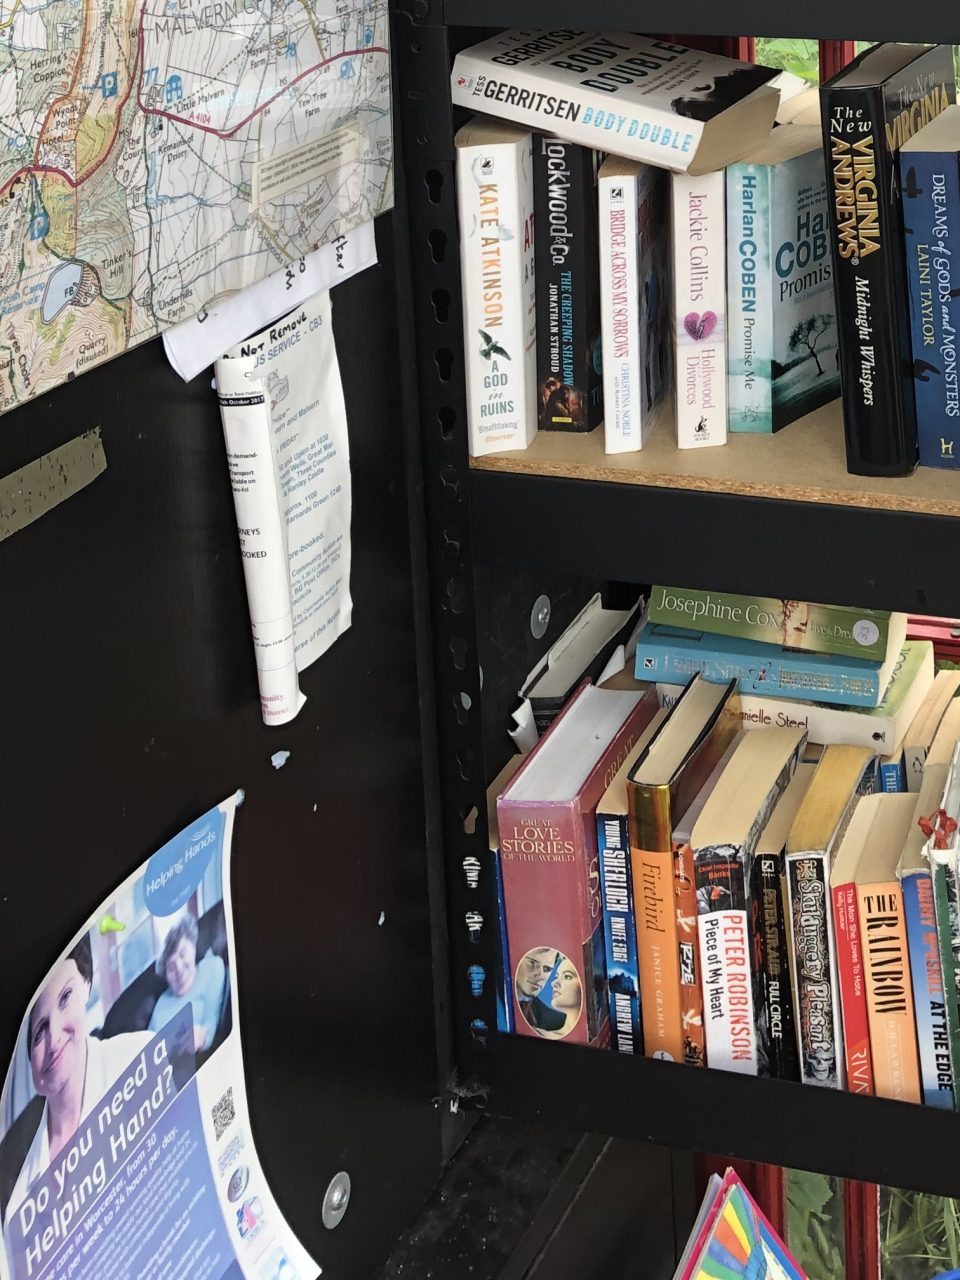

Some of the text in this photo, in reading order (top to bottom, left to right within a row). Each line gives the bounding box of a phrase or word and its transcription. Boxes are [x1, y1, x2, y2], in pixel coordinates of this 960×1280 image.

[155, 2, 238, 44] MALVERN
[473, 74, 694, 153] TESS GERRITSEN BODY DOUBLE
[830, 118, 873, 133] New
[850, 136, 881, 257] VIRGINIA
[478, 183, 504, 328] KATE ATKINSON
[687, 191, 706, 302] Jackie Collins
[159, 290, 193, 310] Underhills
[268, 315, 322, 362] SERVICE CB3
[854, 275, 875, 406] Midnight Whispers
[480, 400, 515, 418] RUINS
[483, 373, 509, 388] GOD
[686, 355, 697, 406] Divorces
[698, 347, 716, 410] Hollywood
[656, 590, 780, 627] Josephine Cox
[146, 831, 216, 895] Helping Hands
[503, 840, 574, 854] STORIES
[513, 827, 560, 840] LOVE
[643, 861, 663, 933] Firebird
[864, 894, 898, 913] THE
[705, 918, 724, 1020] Piece of My Heart
[724, 915, 754, 1062] PETER ROBINSON
[868, 916, 907, 1016] RAINBOW
[20, 1038, 168, 1238] Do you need a
[25, 1157, 106, 1271] Helping
[108, 1066, 176, 1154] Hand?
